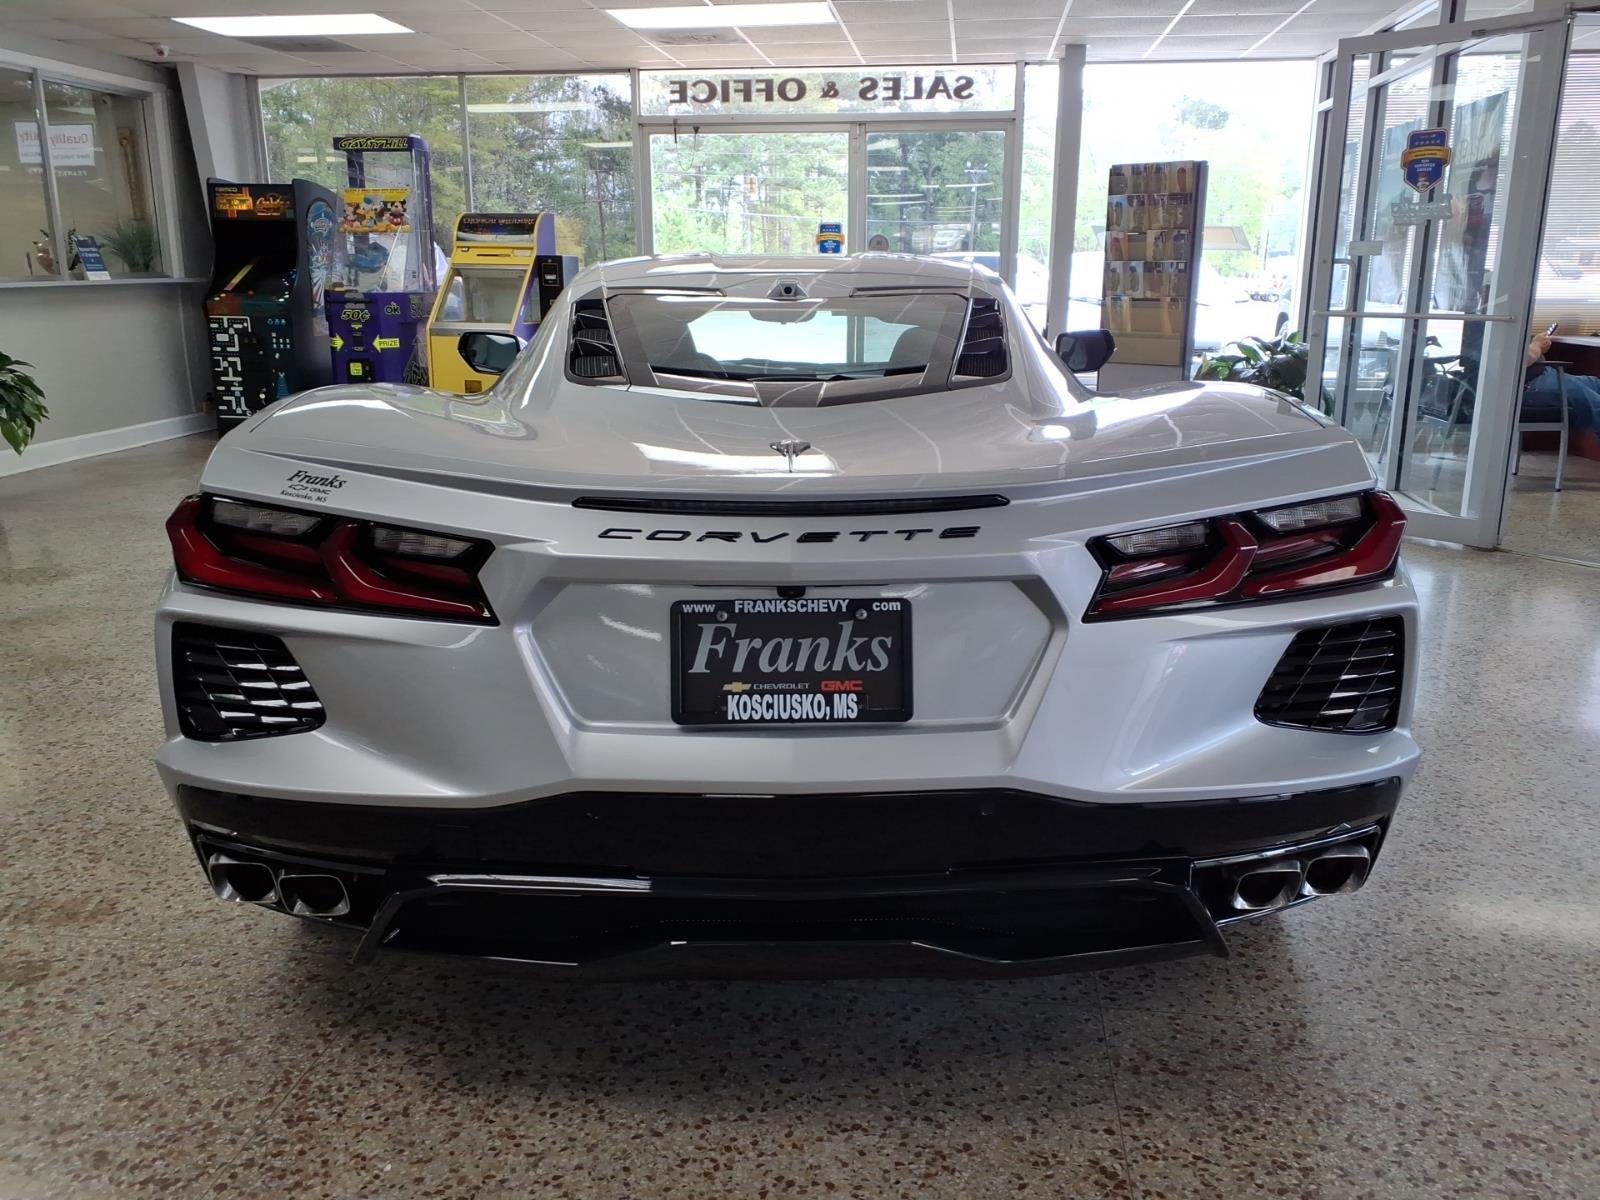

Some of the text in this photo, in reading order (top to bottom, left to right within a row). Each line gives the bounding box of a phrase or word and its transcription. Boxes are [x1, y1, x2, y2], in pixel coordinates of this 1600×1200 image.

[384, 138, 408, 149] HILL
[341, 310, 370, 322] 50¢
[385, 306, 400, 315] OK
[378, 339, 399, 347] PRIZE
[286, 470, 347, 489] Franks
[309, 487, 332, 495] GMC
[597, 526, 981, 543] CORVETTE
[682, 599, 901, 613] www FRANKSCHEVY com
[688, 620, 892, 673] Franks
[753, 680, 863, 692] CHEVROLET GMC
[727, 694, 858, 720] KOSCIUSKO, MS
